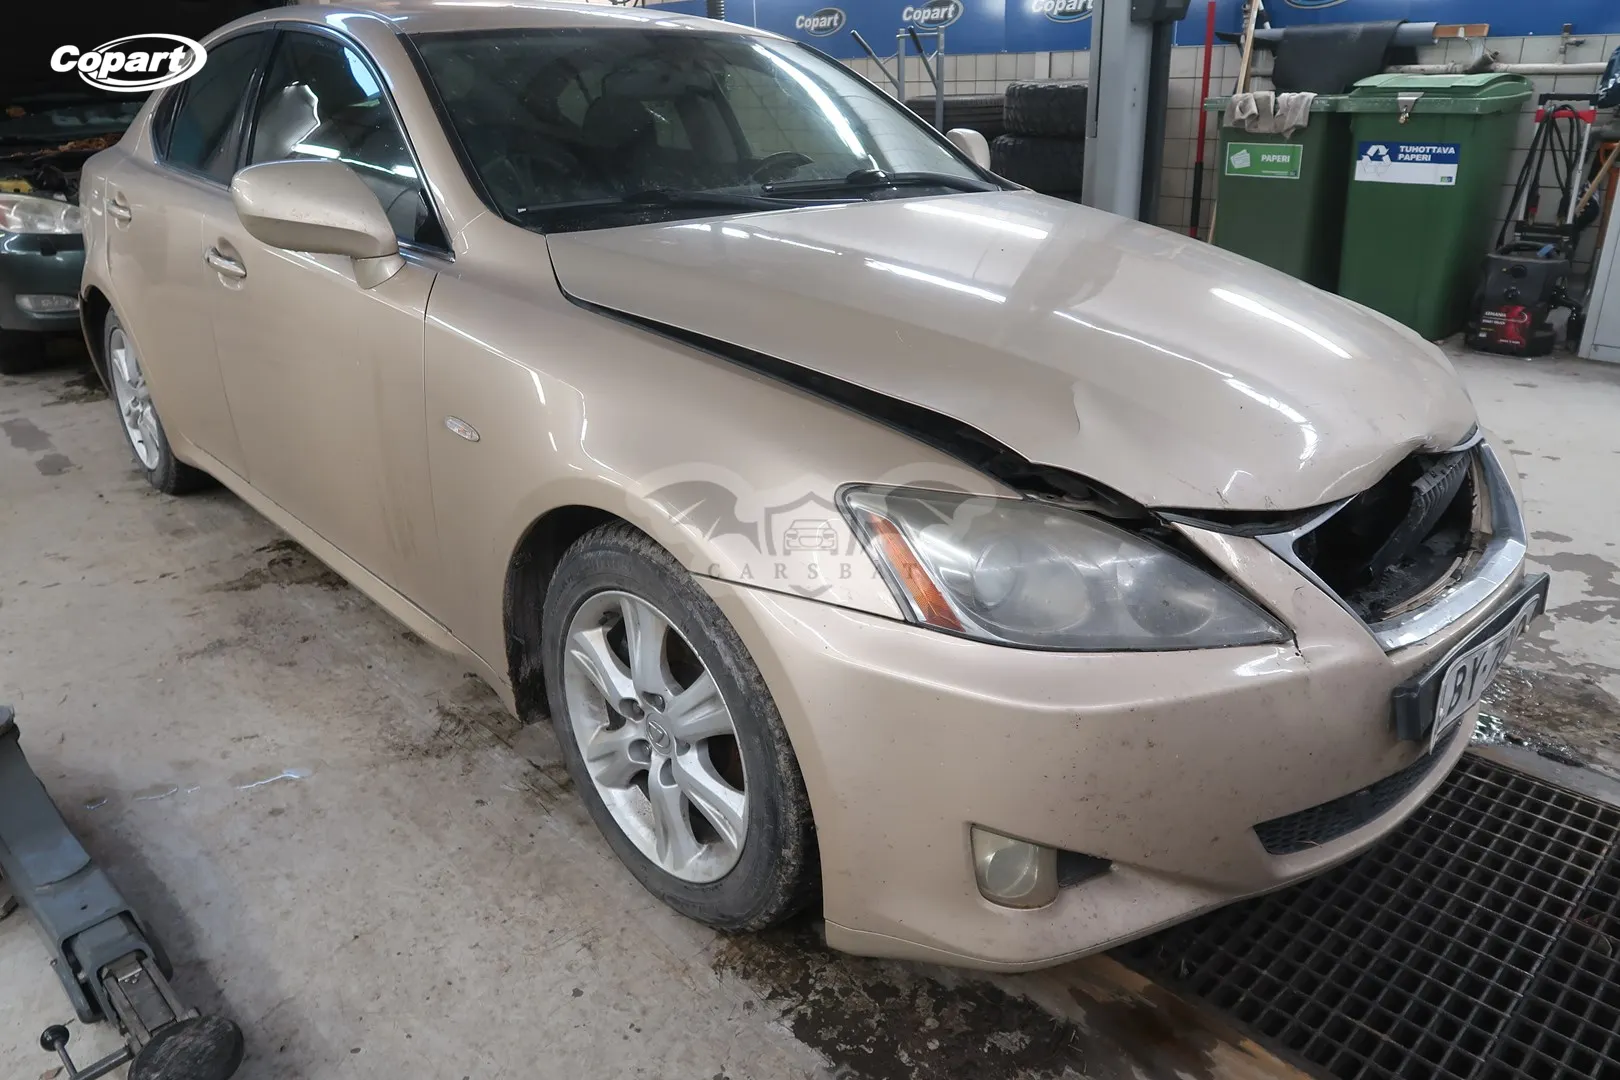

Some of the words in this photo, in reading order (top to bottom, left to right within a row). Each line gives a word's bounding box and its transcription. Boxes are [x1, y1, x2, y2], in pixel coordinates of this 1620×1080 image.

[902, 4, 955, 23] Copart
[795, 12, 840, 31] Copart
[1399, 145, 1456, 154] TUHOTTAVA
[1260, 154, 1291, 163] PAPERI
[1398, 154, 1431, 162] PAPERI
